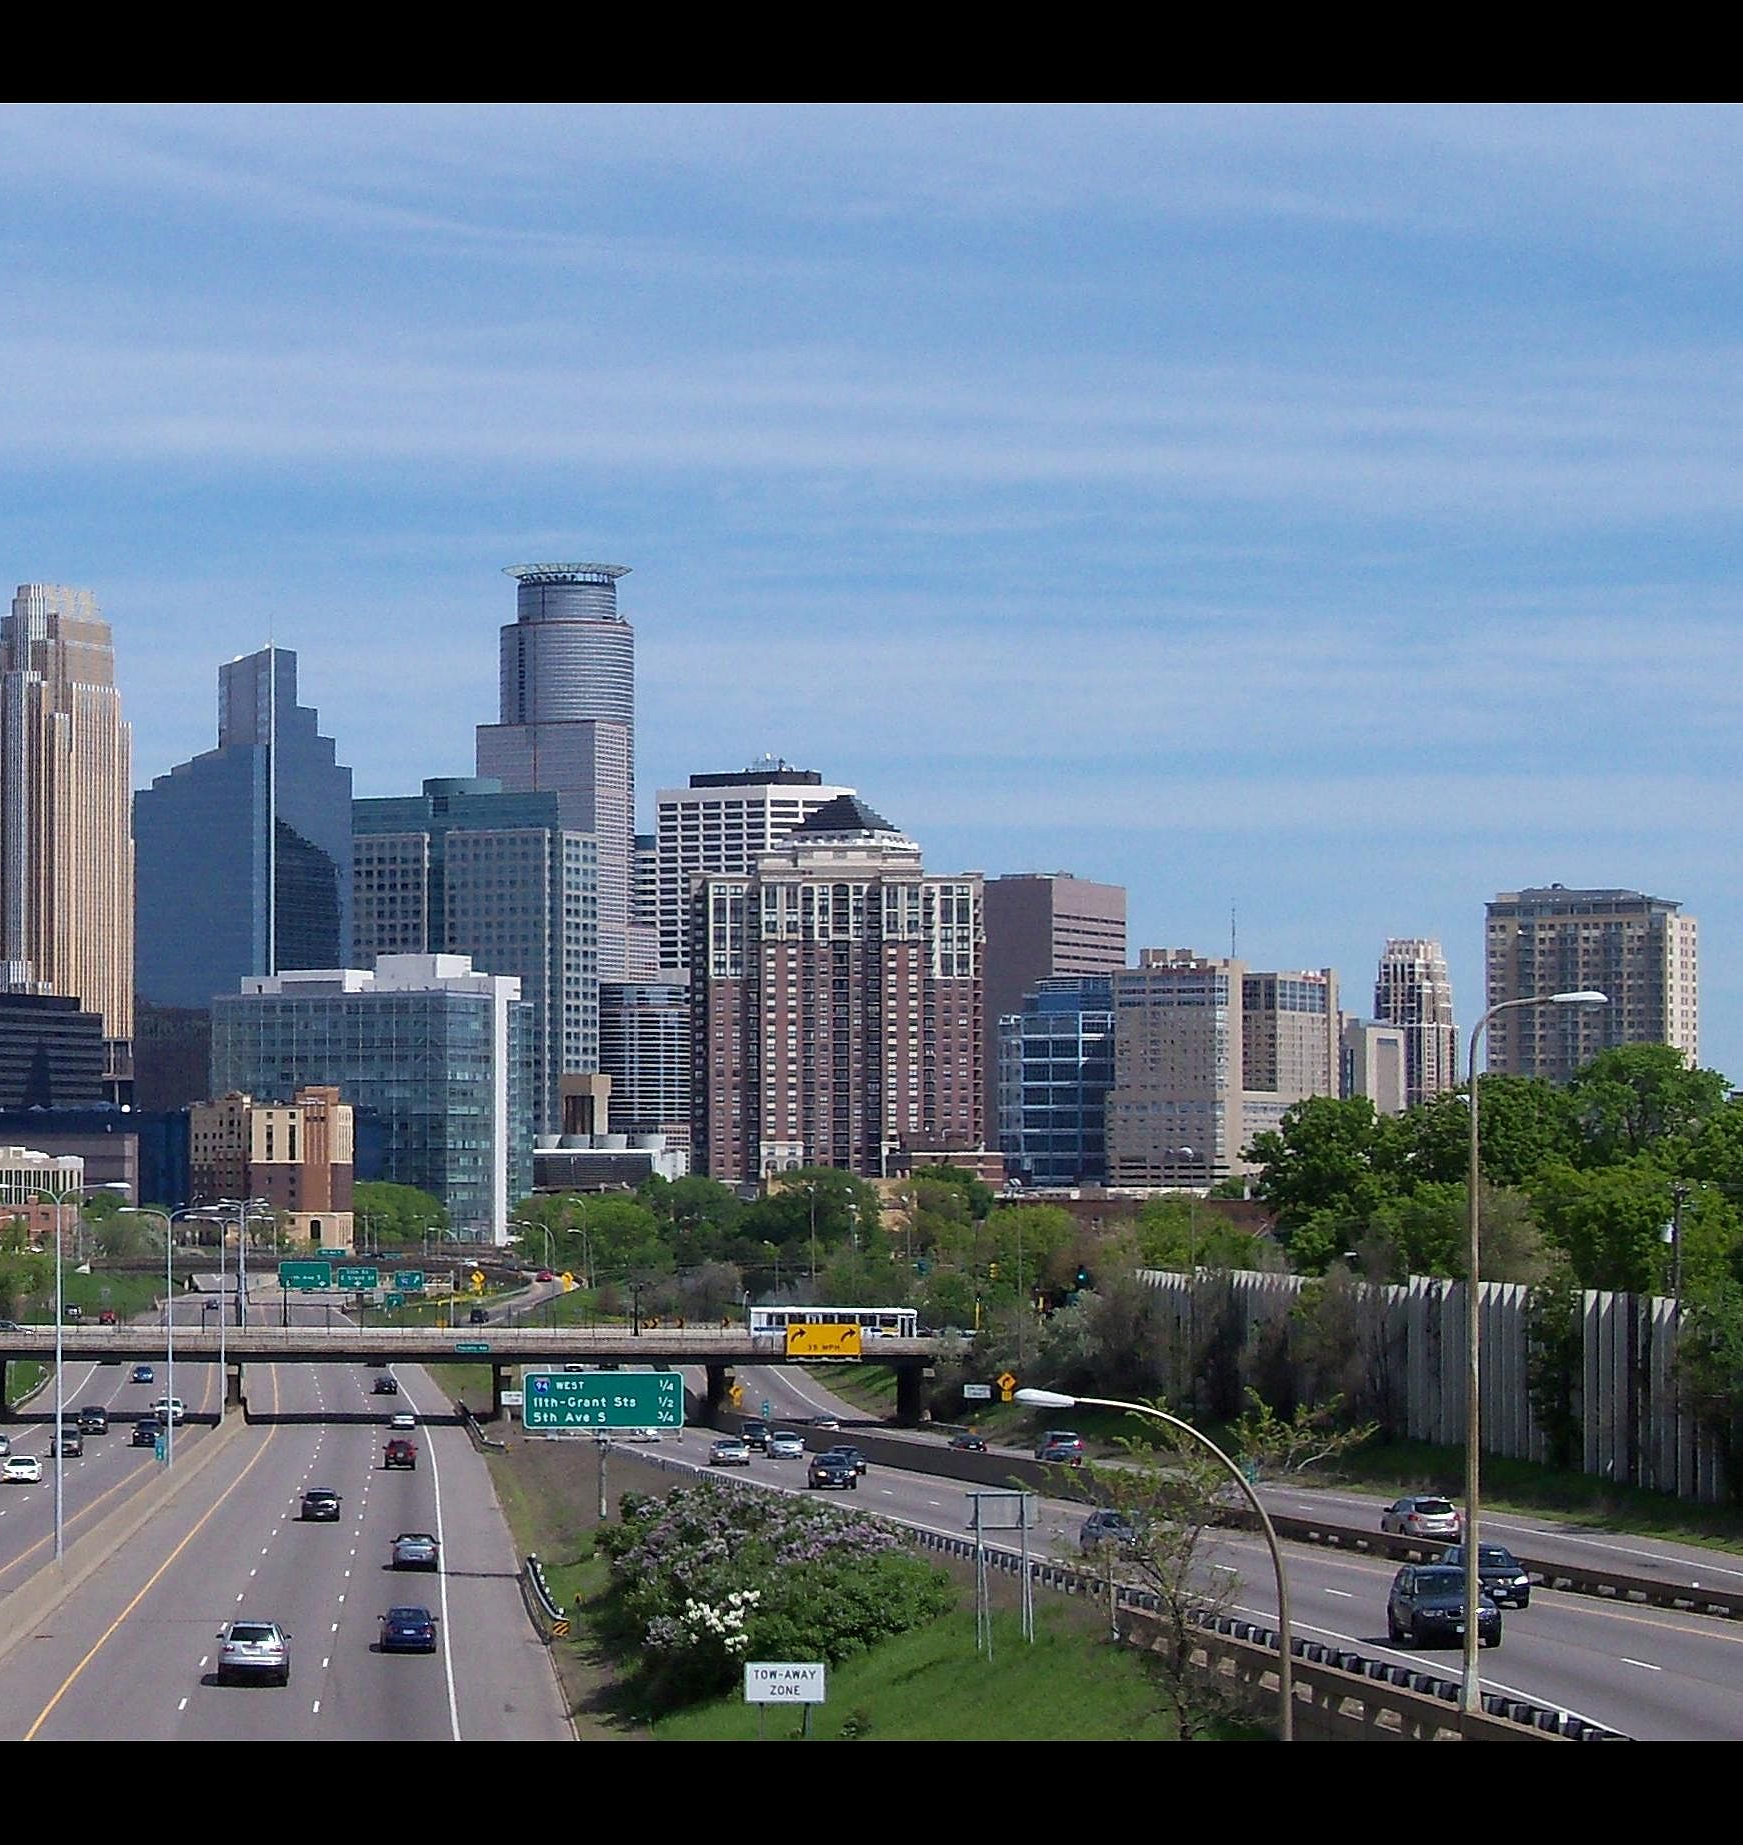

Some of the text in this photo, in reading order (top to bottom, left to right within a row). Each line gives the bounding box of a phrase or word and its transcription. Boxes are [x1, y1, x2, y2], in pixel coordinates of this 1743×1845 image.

[535, 1382, 548, 1390] 94
[556, 1381, 585, 1390] WEST
[533, 1397, 607, 1407] 11th-Grant
[613, 1397, 636, 1407] Sts
[533, 1411, 557, 1423] 5th
[565, 1412, 590, 1423] Ave
[597, 1412, 606, 1423] S
[754, 1669, 816, 1680] TOW-AWAY
[769, 1684, 800, 1696] ZONE
